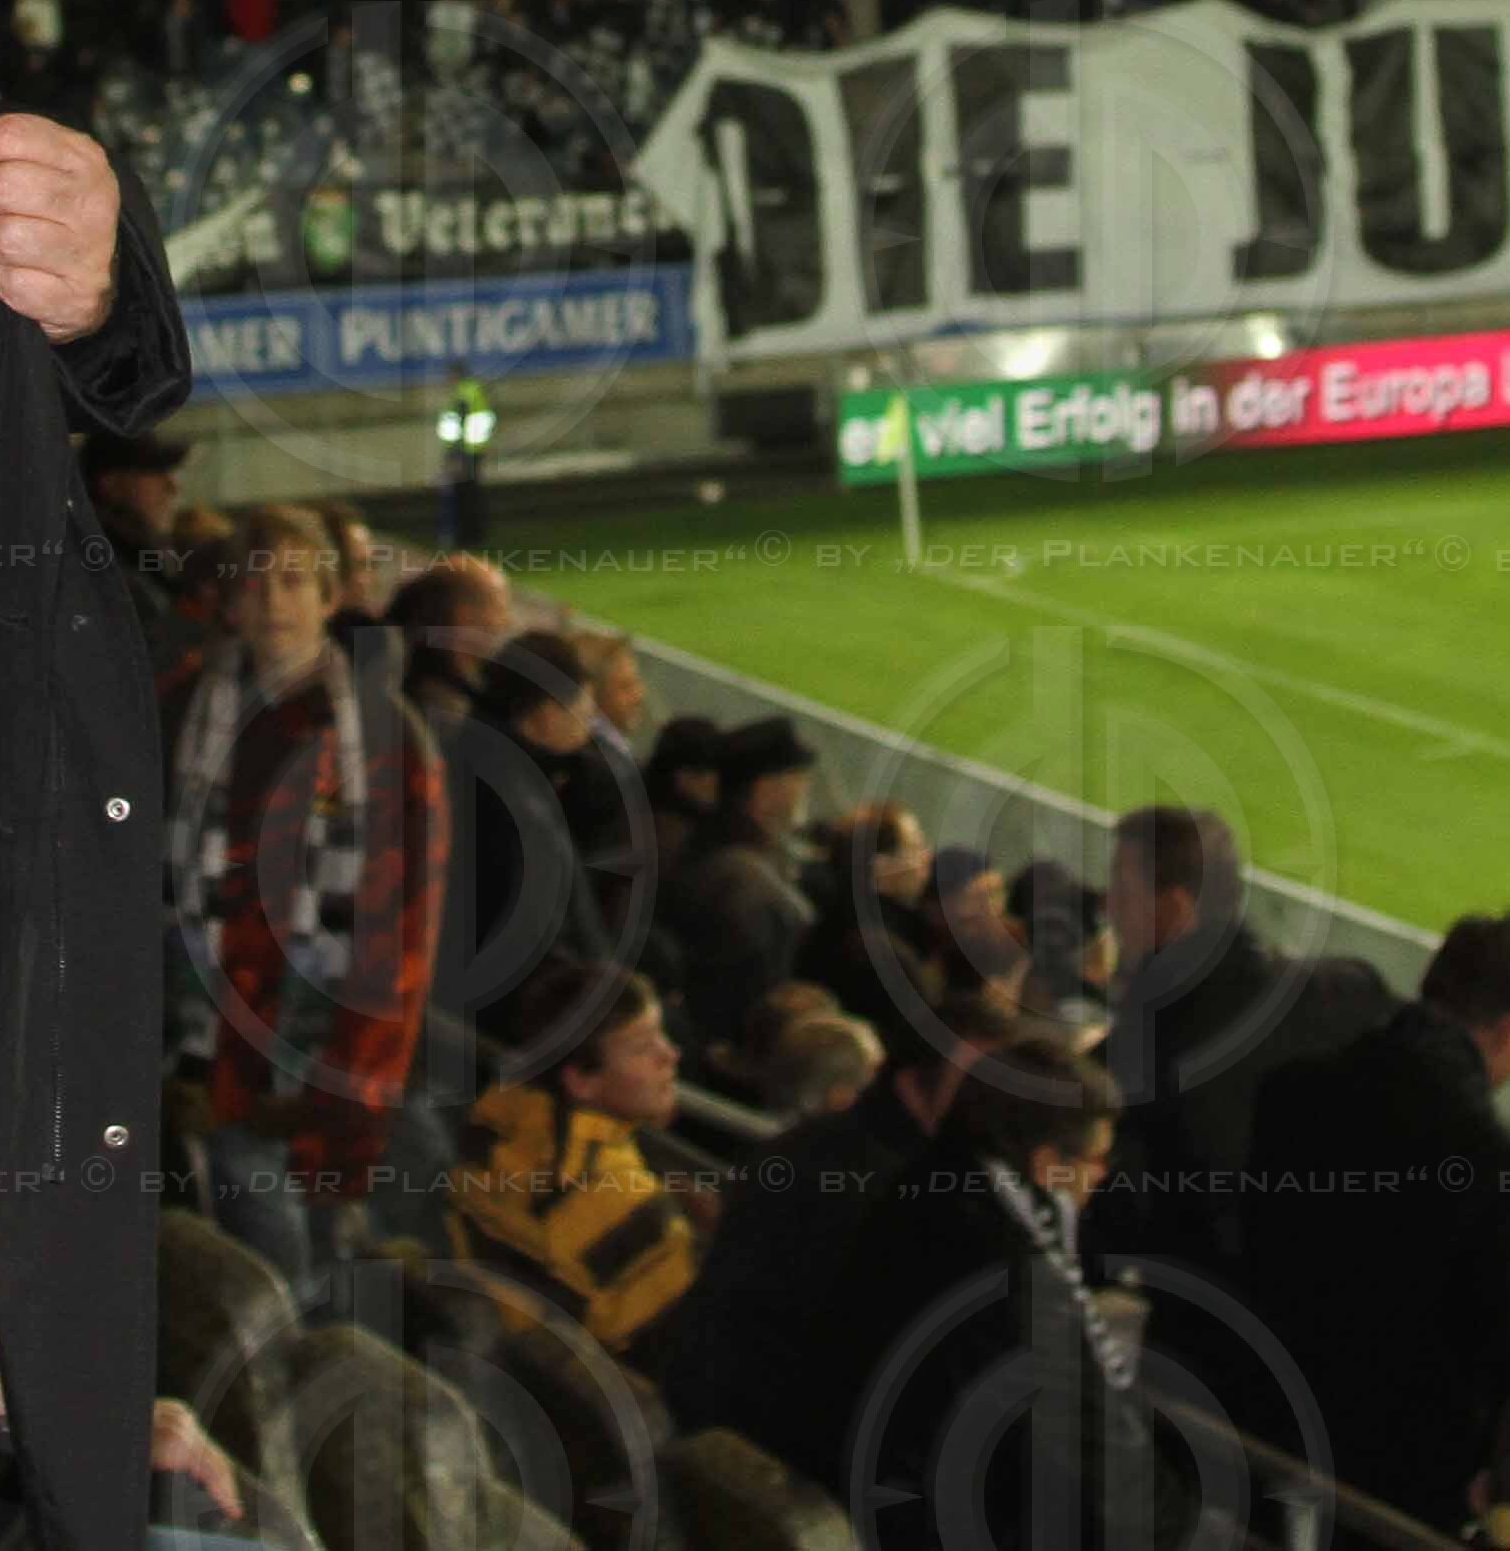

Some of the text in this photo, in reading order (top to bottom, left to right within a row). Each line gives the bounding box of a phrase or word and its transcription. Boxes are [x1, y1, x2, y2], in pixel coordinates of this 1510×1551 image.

[697, 42, 1082, 339] DIE
[338, 290, 658, 365] PUNTIGAMER
[917, 396, 1006, 457] viel
[1014, 385, 1161, 453] Erfolg
[1170, 375, 1219, 434] in
[1228, 369, 1311, 430] der
[1319, 360, 1490, 423] Europa
